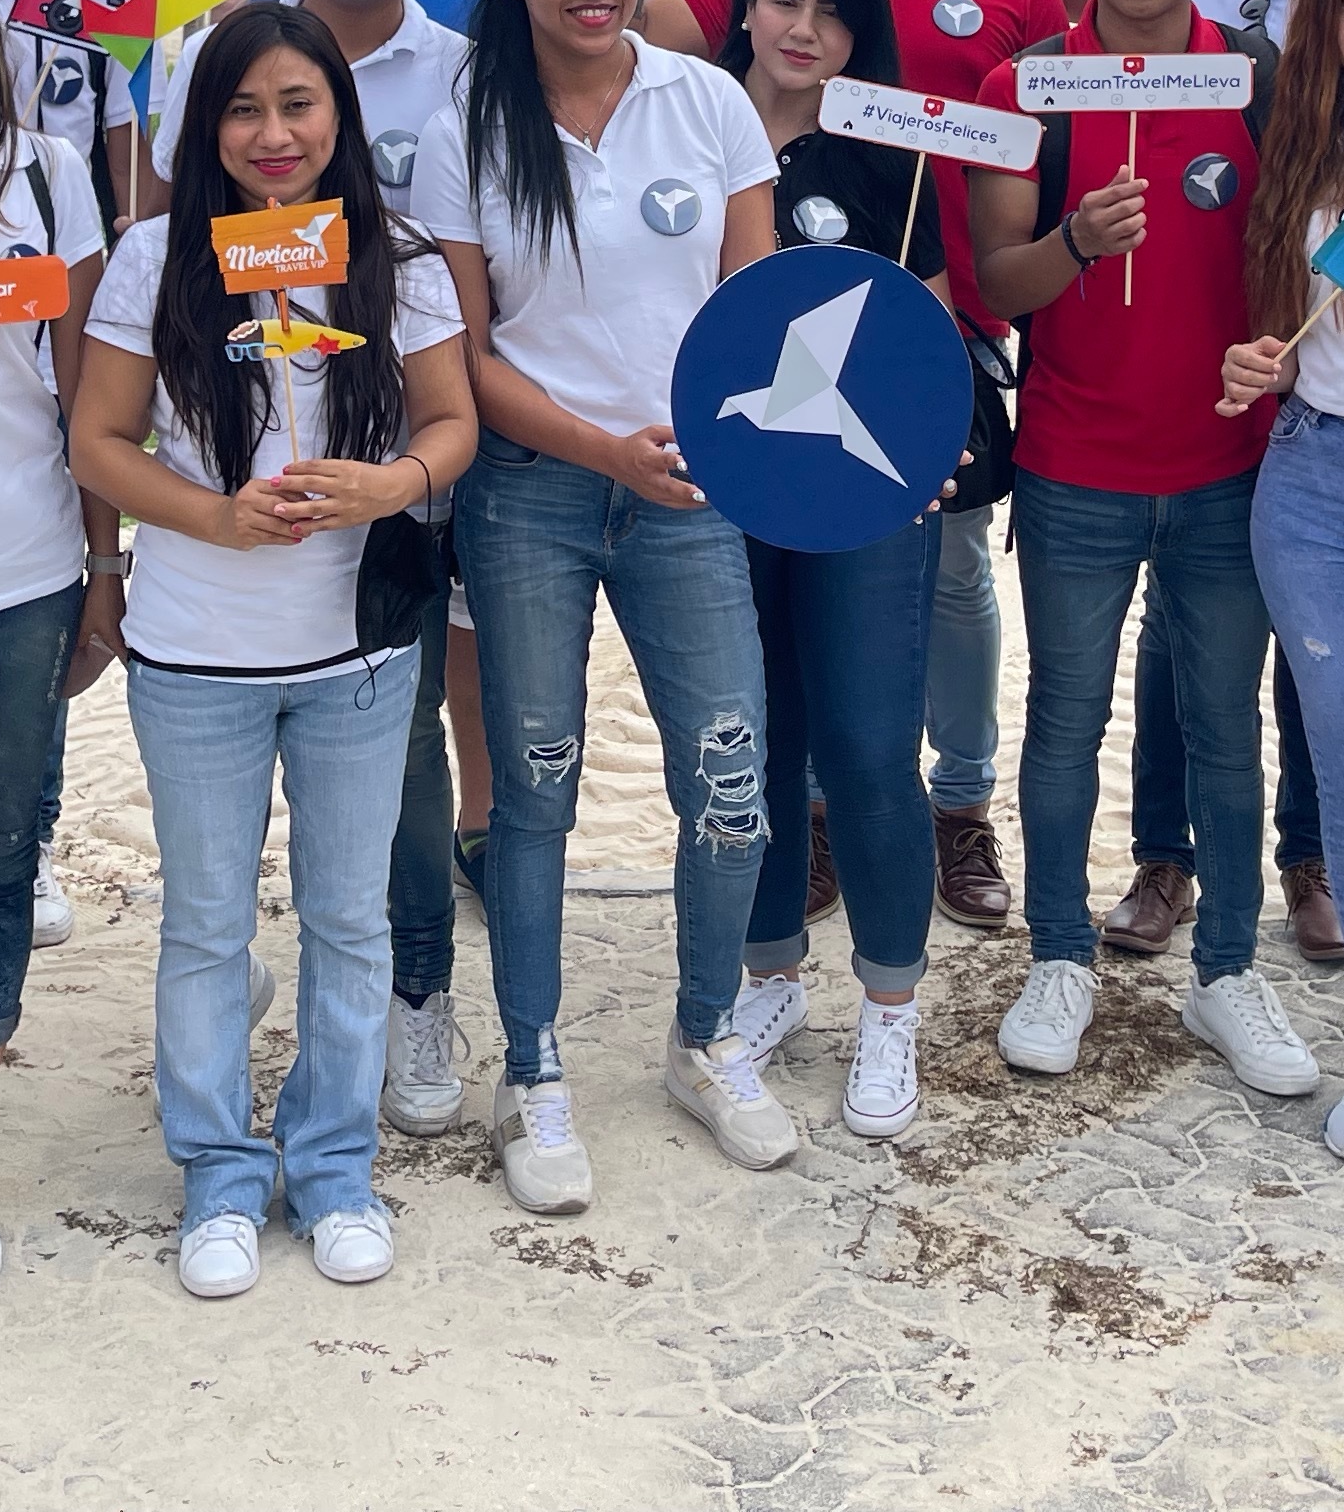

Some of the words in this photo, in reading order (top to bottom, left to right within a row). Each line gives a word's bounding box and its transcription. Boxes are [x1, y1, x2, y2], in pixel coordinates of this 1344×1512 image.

[1027, 74, 1240, 90] #MexicanTravelMeLleva
[862, 104, 997, 144] #ViajerosFelices
[225, 244, 316, 272] Mexican
[275, 261, 310, 273] TRAVEL
[311, 259, 327, 269] VIP
